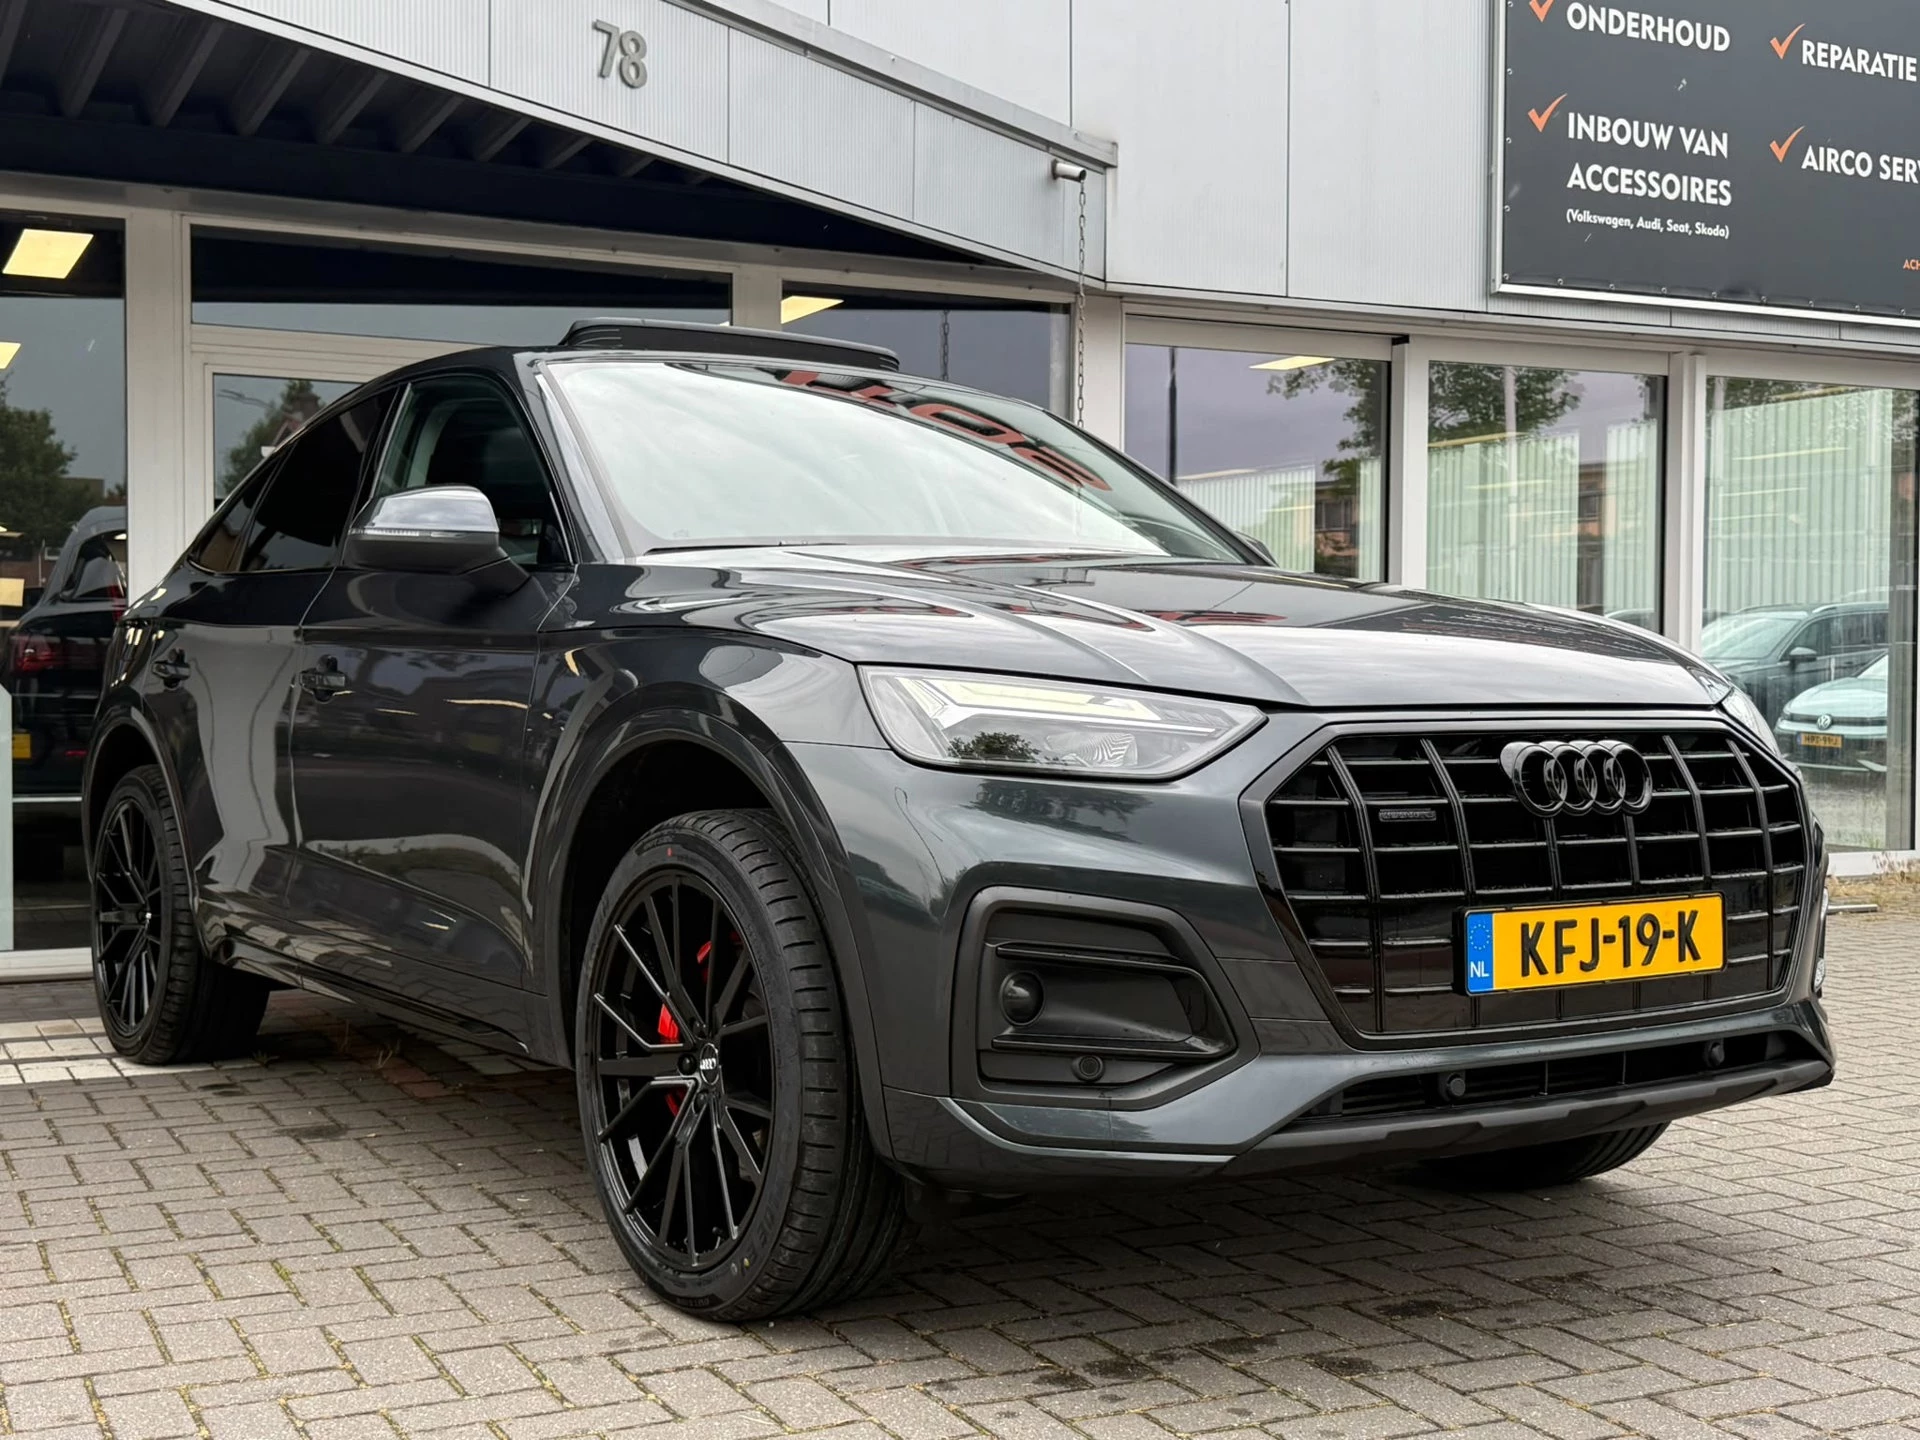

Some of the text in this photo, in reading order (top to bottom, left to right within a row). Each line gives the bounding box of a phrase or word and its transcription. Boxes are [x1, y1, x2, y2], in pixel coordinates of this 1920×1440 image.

[1566, 2, 1731, 52] ONDERHOUD
[592, 18, 647, 89] 78
[1802, 39, 1918, 82] REPARATIE
[1568, 112, 1728, 159] INBOUW VAN
[1566, 162, 1732, 207] ACCESSOIRES
[1801, 145, 1920, 184] AIRCO SER
[1566, 208, 1729, 239] (Volkswagen, Audi, Seat, Skoda)
[1470, 909, 1702, 979] NL KFJ-19-K
